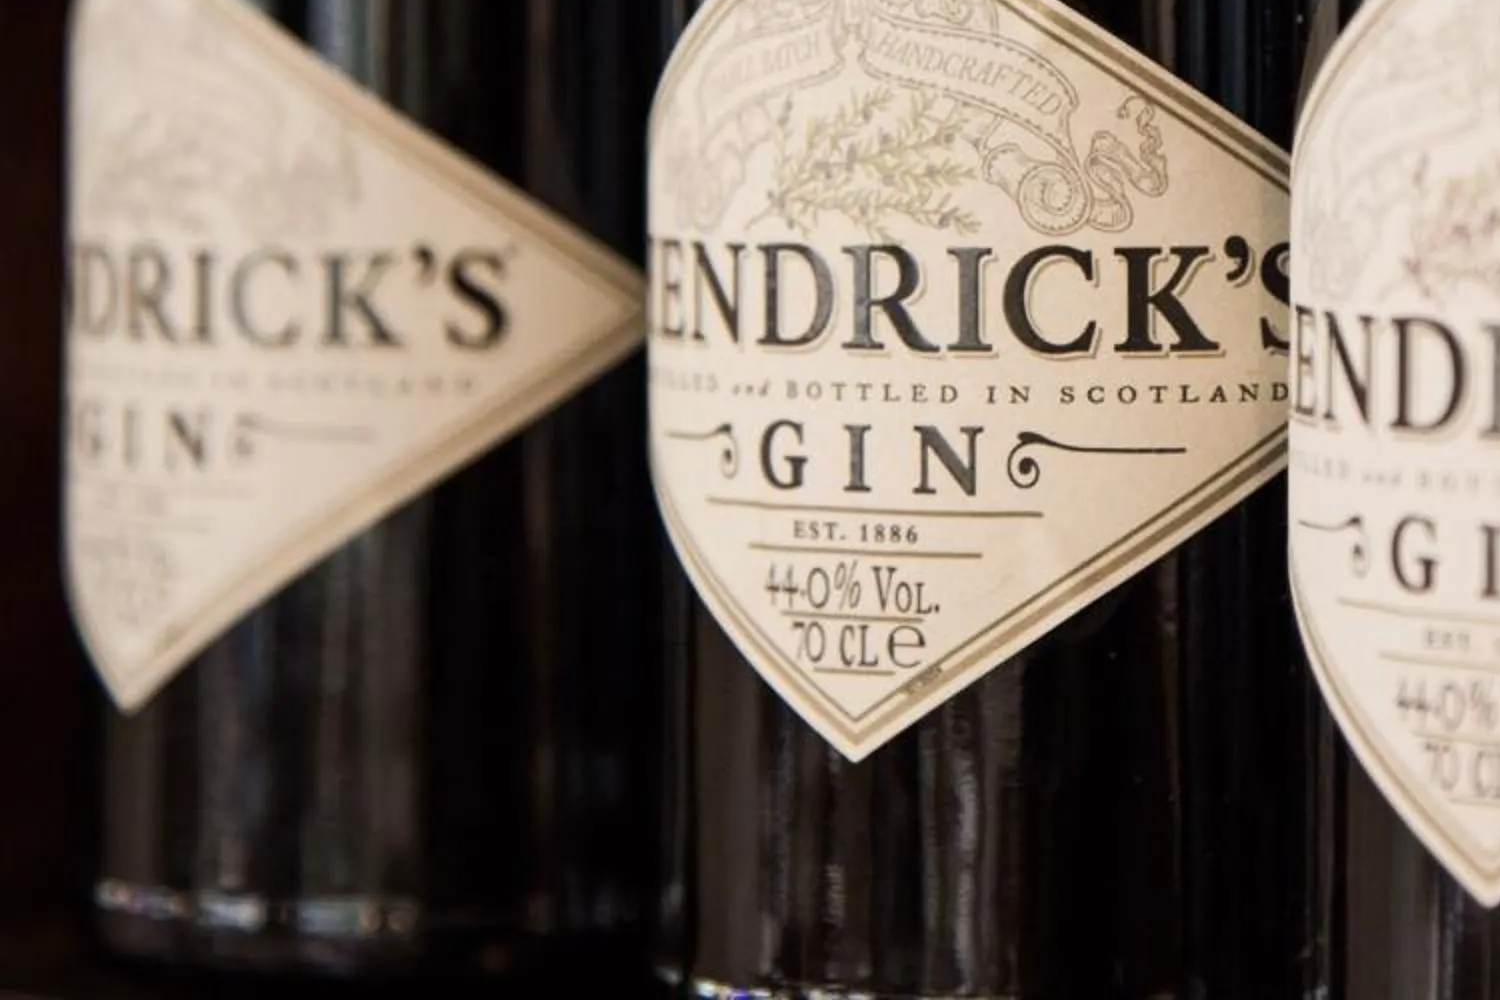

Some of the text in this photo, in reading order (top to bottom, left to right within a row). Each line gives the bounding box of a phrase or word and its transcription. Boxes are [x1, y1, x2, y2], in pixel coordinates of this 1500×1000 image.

[877, 30, 1062, 116] HANDCRAFTED
[75, 241, 512, 351] DRICK'S
[653, 235, 1290, 354] ENDRICK'
[786, 380, 958, 404] BOTTLED
[987, 385, 1030, 405] IN
[1061, 382, 1289, 405] SCOTLAND
[760, 419, 984, 496] GIN
[794, 520, 918, 544] EST. 1886
[791, 621, 826, 663] 70
